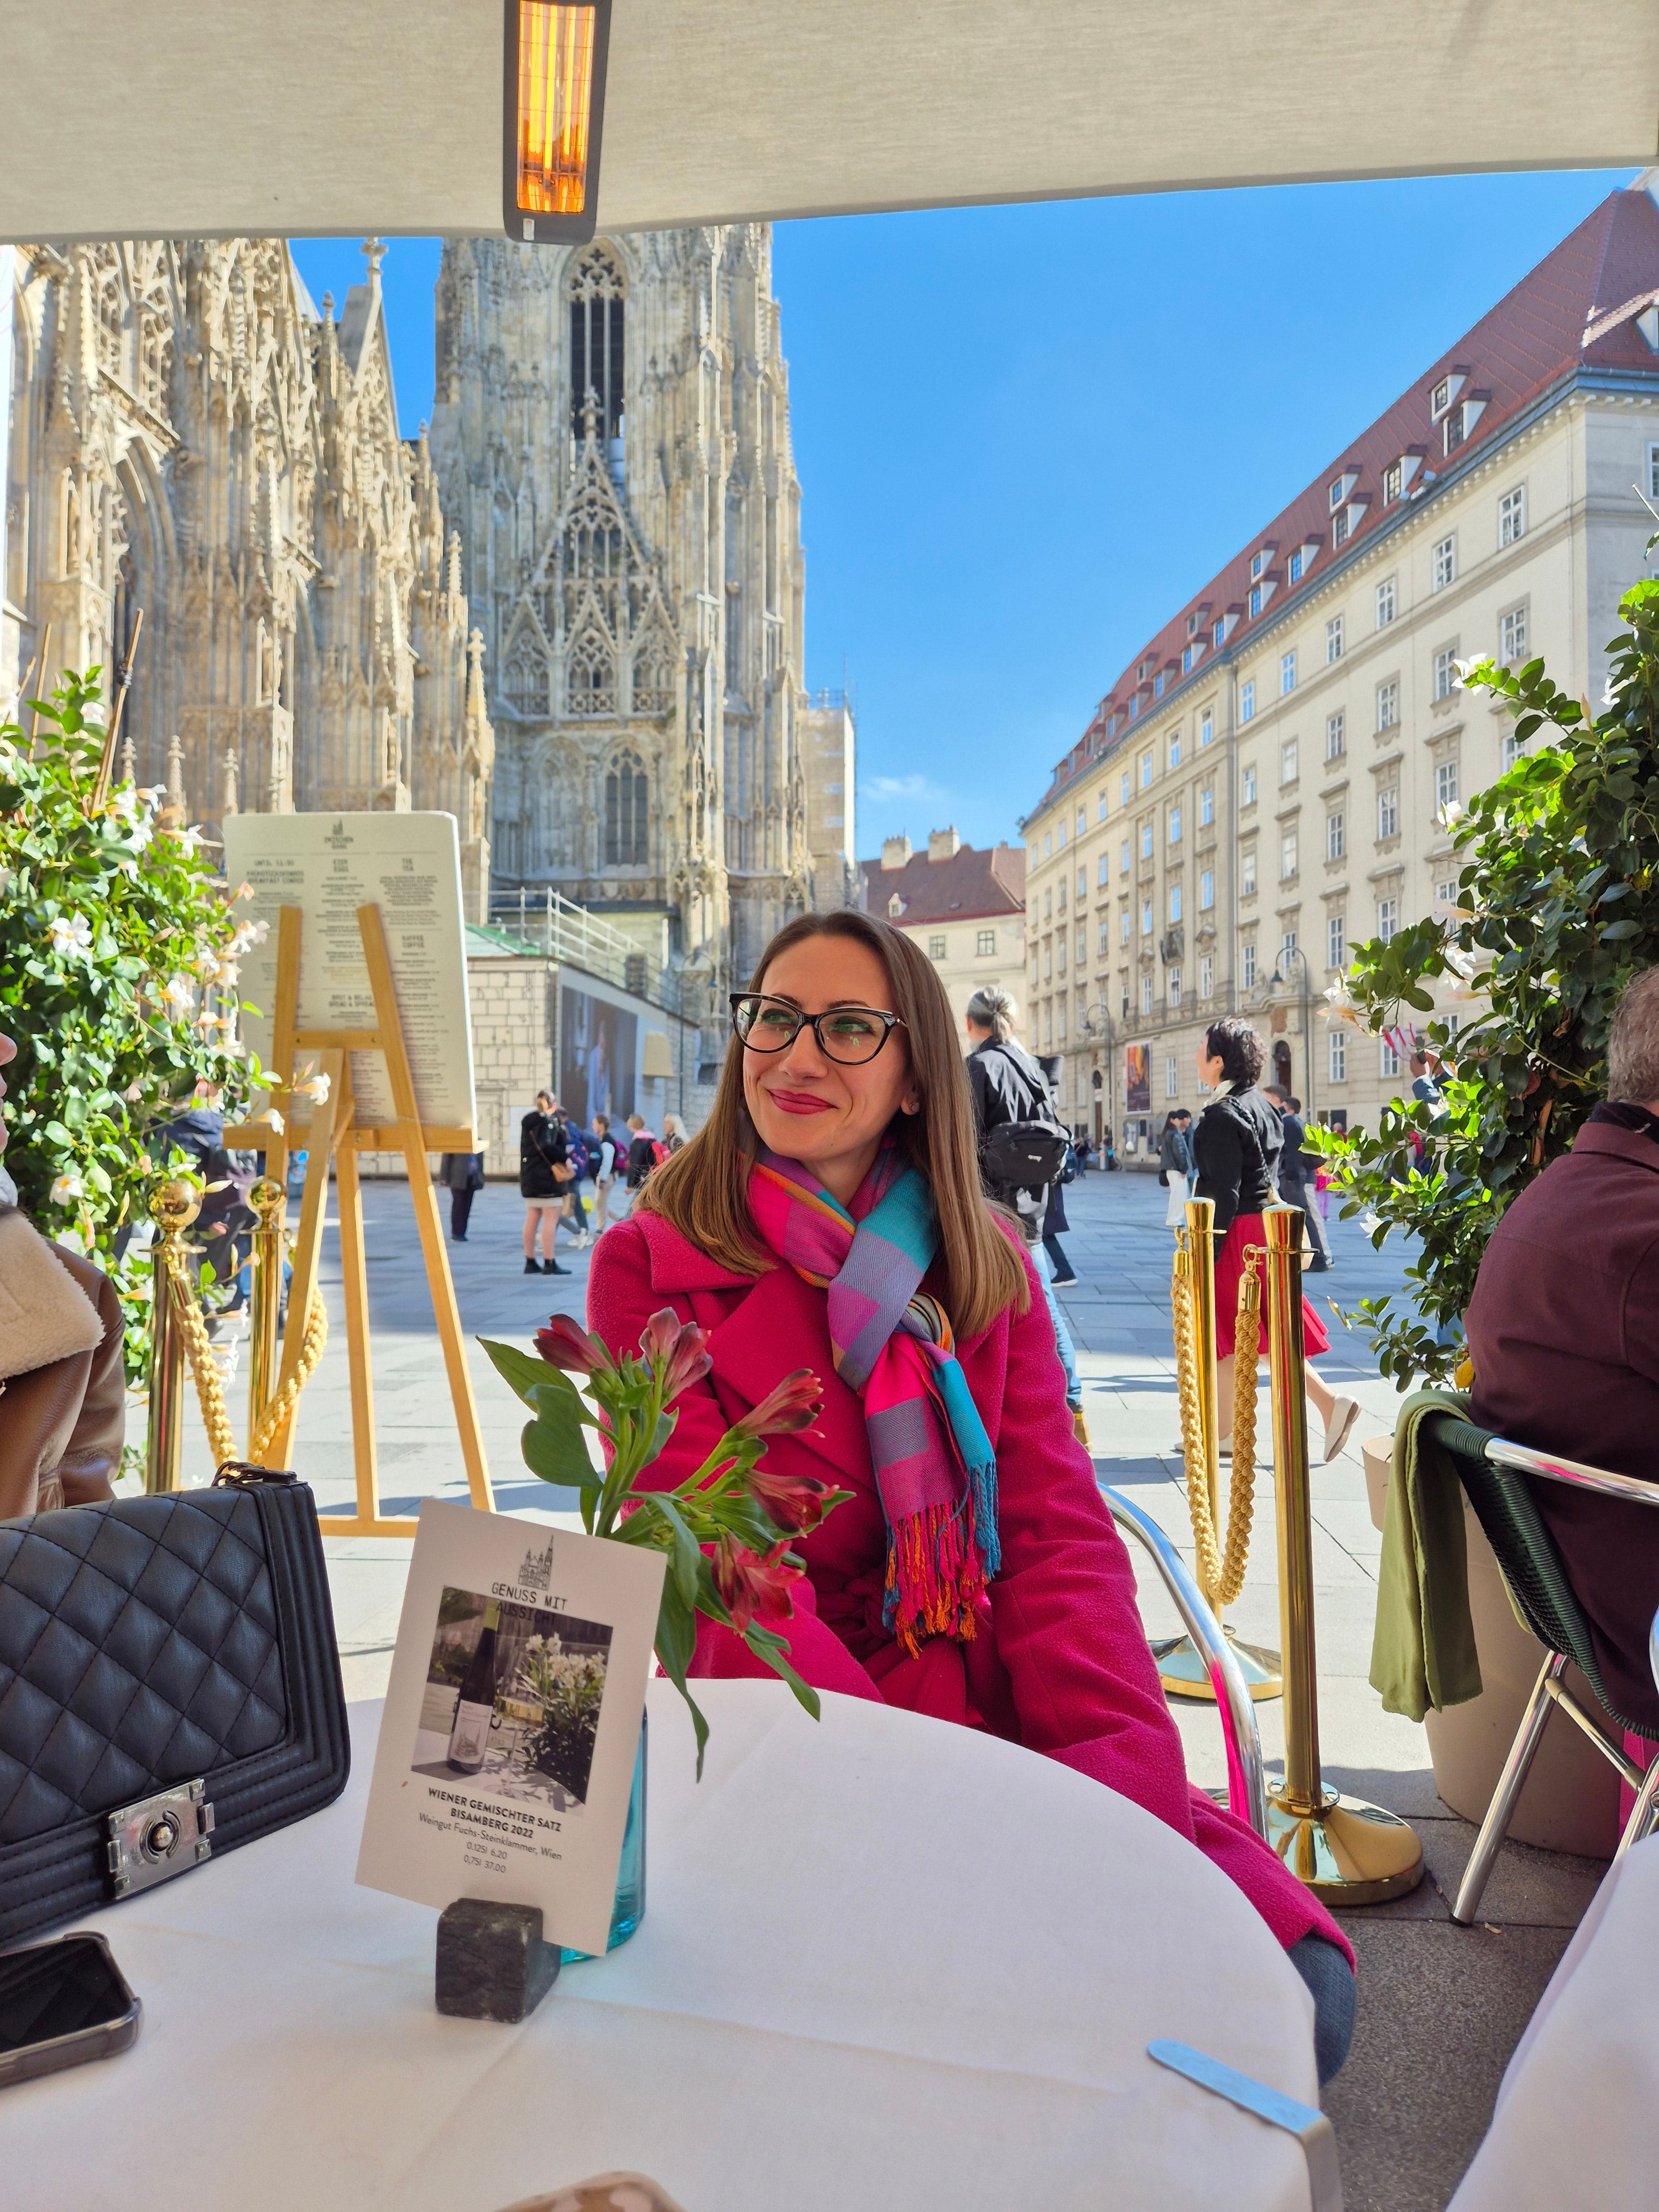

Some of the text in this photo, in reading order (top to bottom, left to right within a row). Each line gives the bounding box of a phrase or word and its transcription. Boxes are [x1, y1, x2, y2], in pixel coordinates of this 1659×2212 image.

[492, 1582, 568, 1610] GENUSS MIT
[496, 1601, 558, 1625] AUSSICHT
[428, 1787, 562, 1832] WIENER GEMISCHTER SATZ
[450, 1807, 534, 1839] BISAMBERG 2022
[419, 1812, 562, 1860] Weingut Fuchs-Steinklammer, Wien
[484, 1860, 507, 1874] 37.00
[491, 1849, 508, 1860] 6.20
